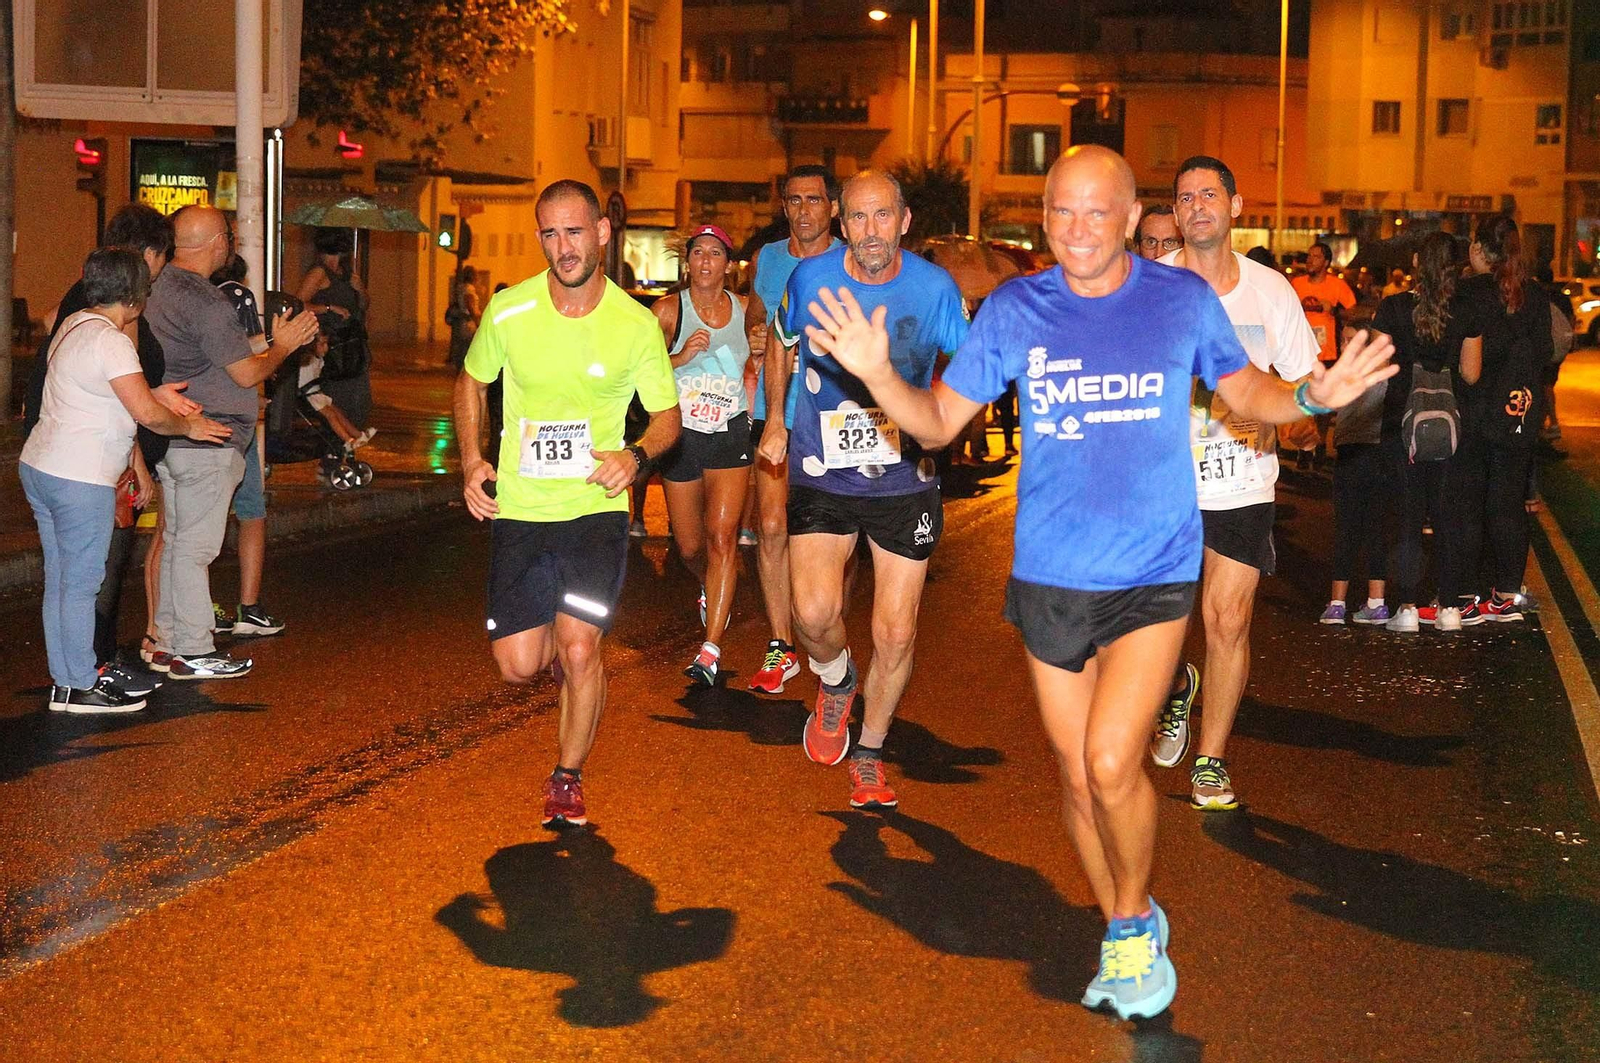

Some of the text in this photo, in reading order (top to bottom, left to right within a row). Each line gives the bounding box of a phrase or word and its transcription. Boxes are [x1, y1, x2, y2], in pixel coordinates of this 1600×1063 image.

[160, 174, 167, 186] A
[168, 175, 177, 186] LA
[140, 186, 208, 204] CRUZCAMPO
[678, 373, 740, 396] adida
[700, 391, 732, 403] NOCTURNA
[690, 402, 721, 422] 249
[539, 423, 586, 433] NOCTURNA
[844, 418, 888, 428] DE HUELVA
[537, 431, 585, 440] DE HUELVA
[838, 427, 878, 450] 323
[531, 439, 572, 461] 133
[1204, 438, 1248, 452] NOCTURNA
[1199, 455, 1235, 481] 537
